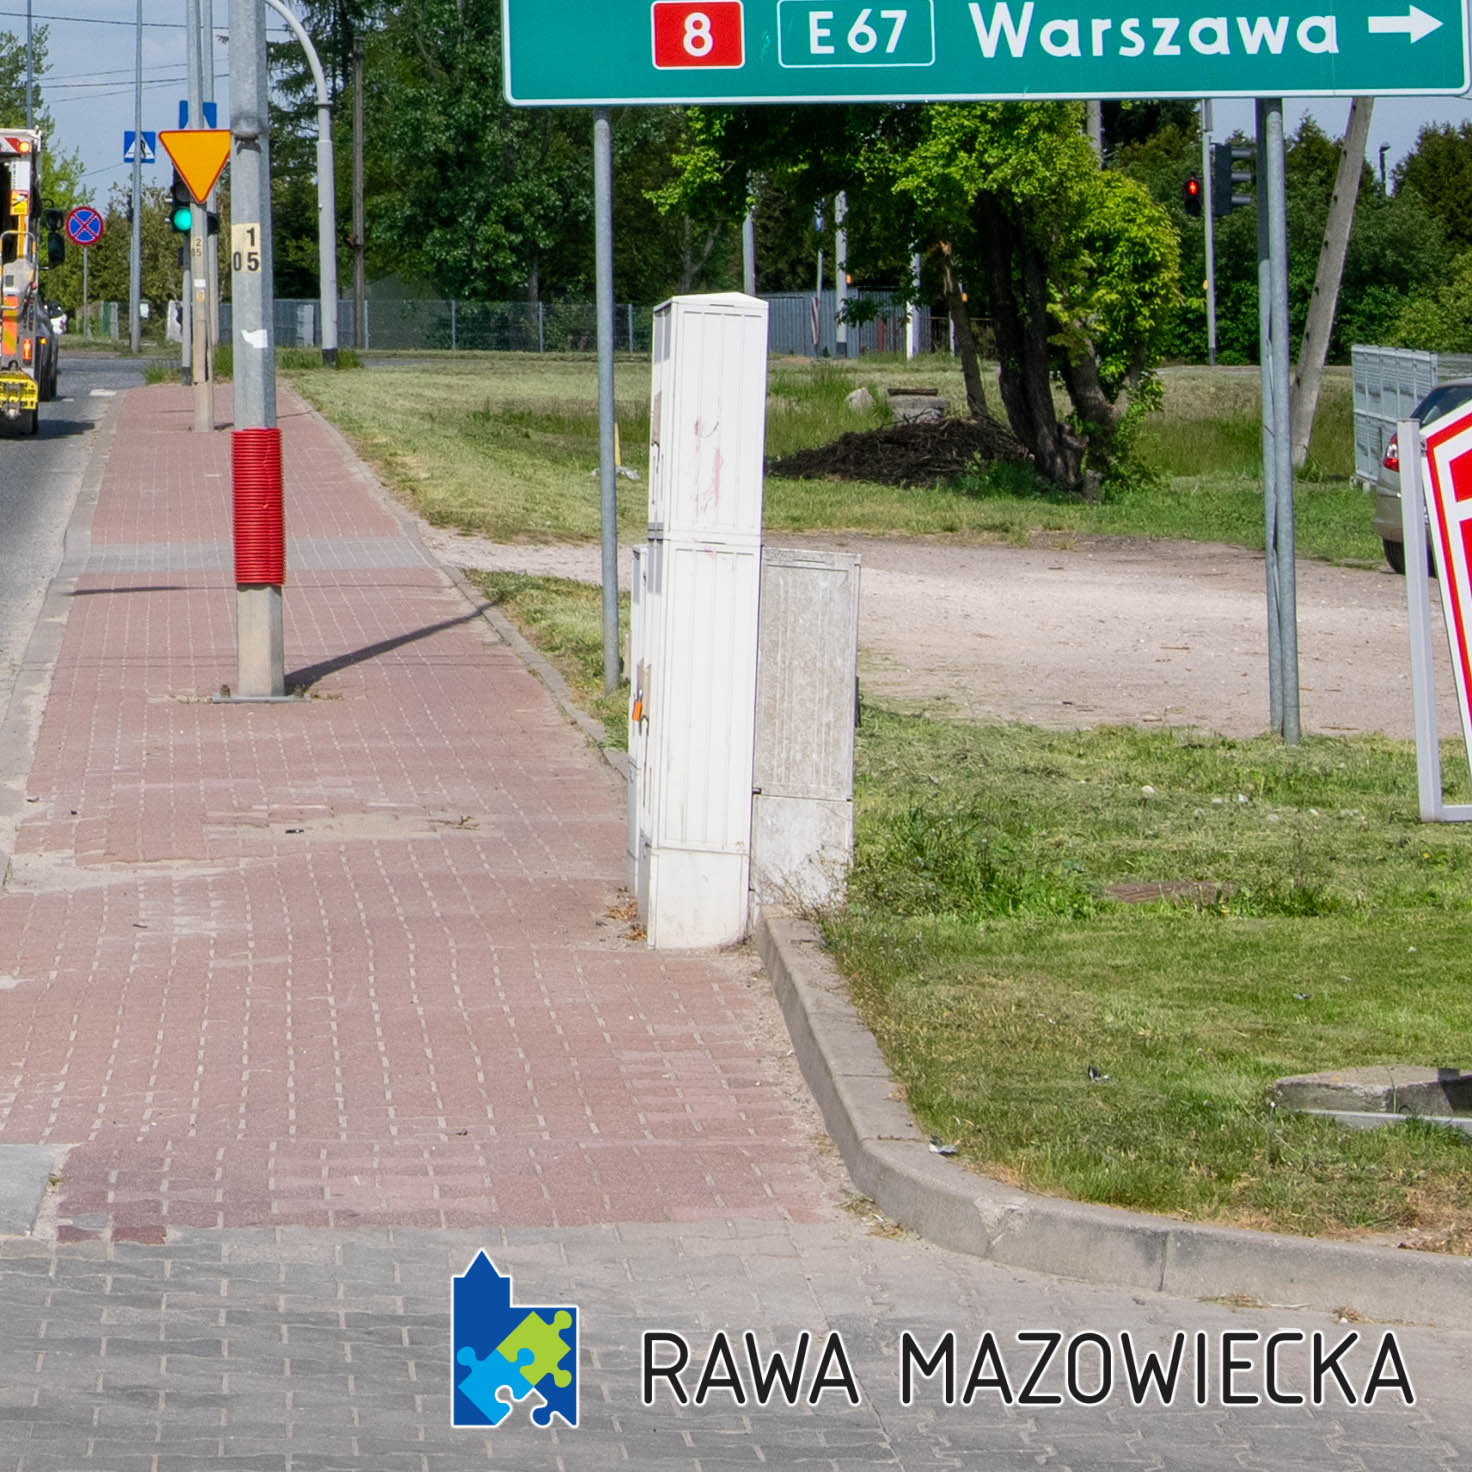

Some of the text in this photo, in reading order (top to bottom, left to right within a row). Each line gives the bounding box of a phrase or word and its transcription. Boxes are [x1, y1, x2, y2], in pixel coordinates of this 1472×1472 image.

[682, 12, 714, 57] 8
[967, 1, 1340, 58] Warszawa
[246, 227, 255, 247] 1
